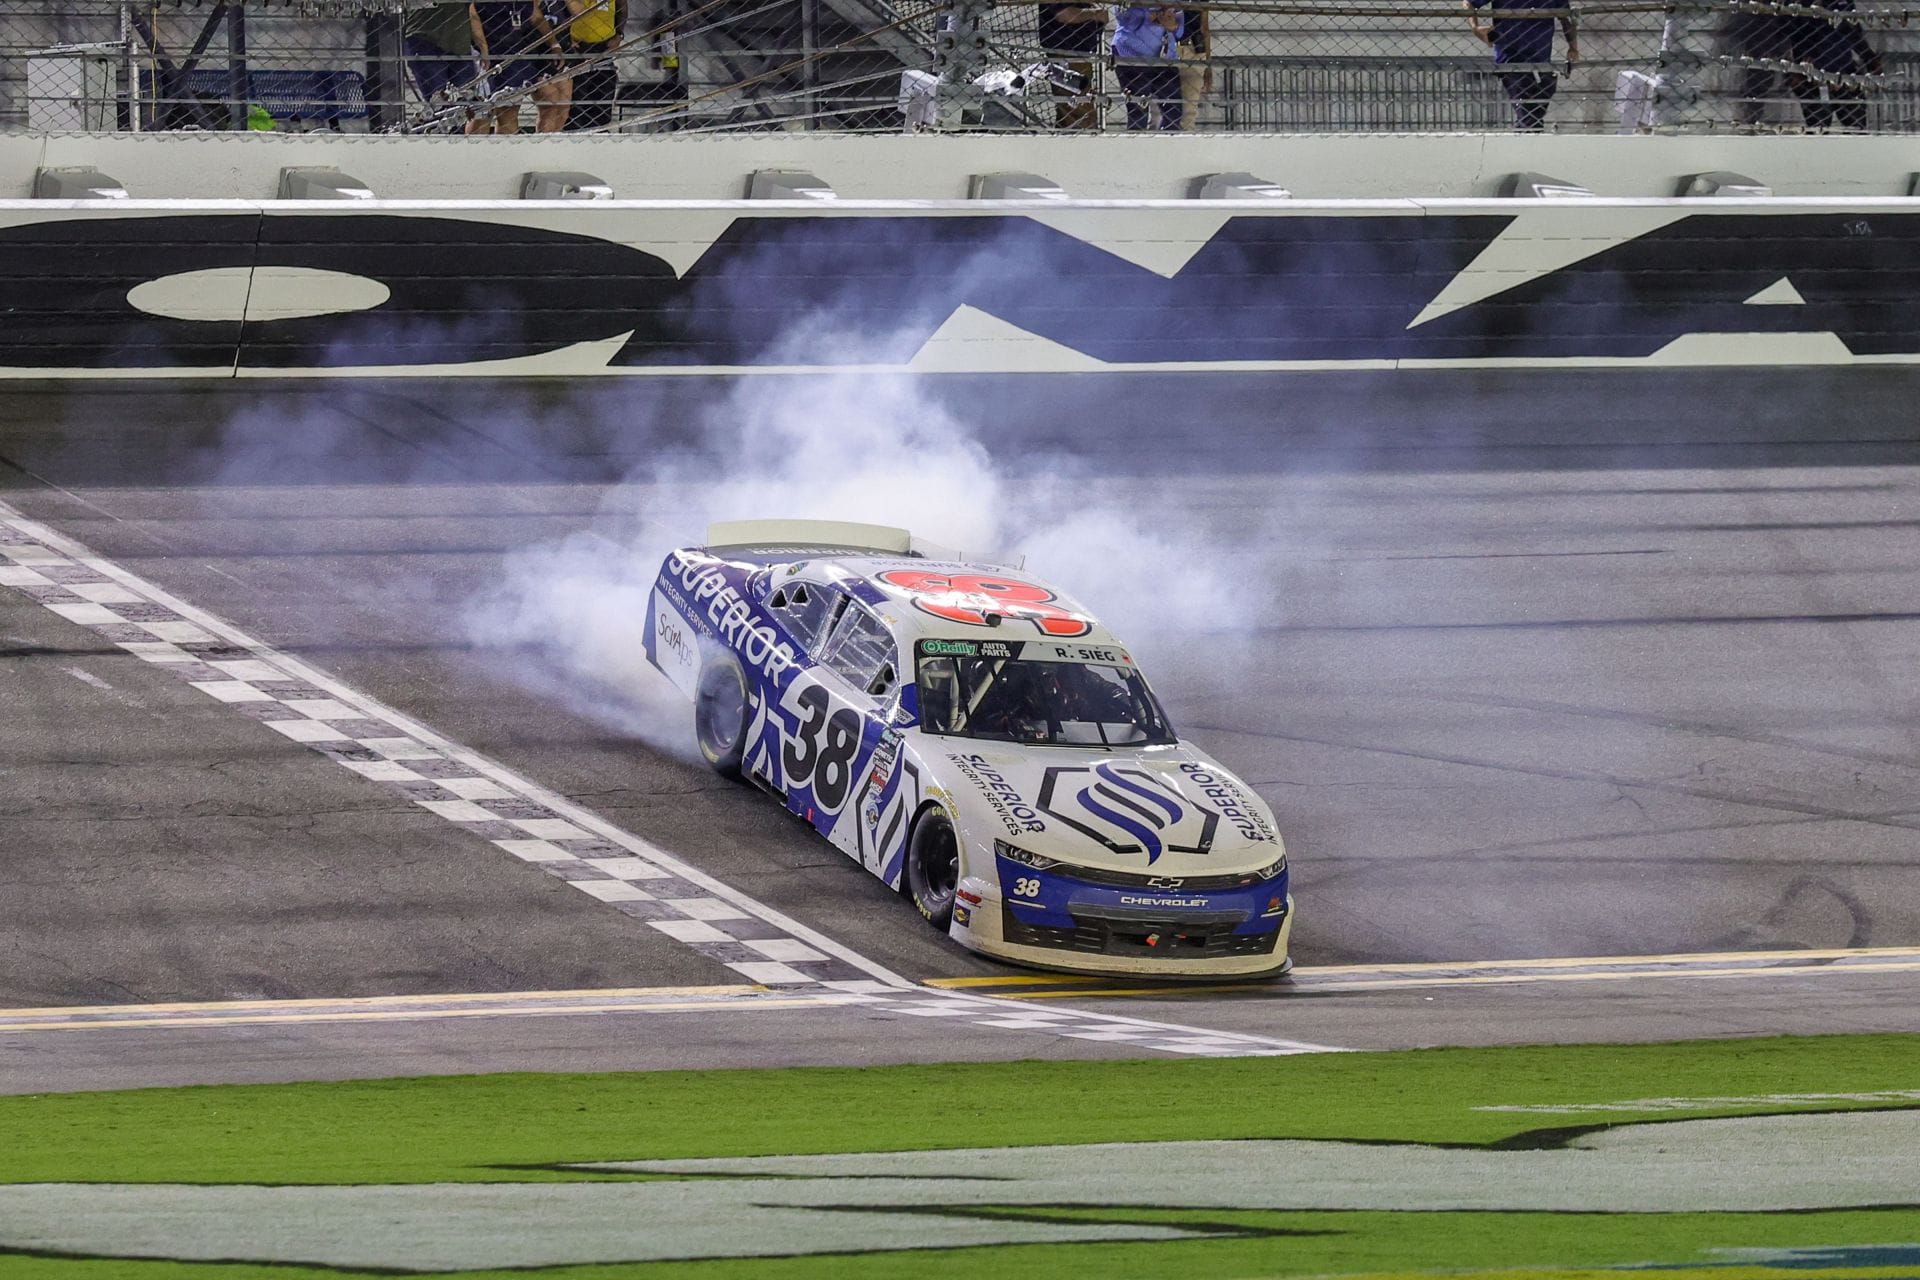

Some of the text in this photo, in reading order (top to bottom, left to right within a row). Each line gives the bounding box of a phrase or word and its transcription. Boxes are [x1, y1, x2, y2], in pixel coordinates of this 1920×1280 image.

[660, 574, 713, 640] INTEGRITY SERVICES
[668, 555, 795, 689] SUPERIOR
[922, 639, 977, 656] O'Reilly
[981, 649, 1011, 658] PARTS
[982, 642, 1006, 651] AUTO
[1055, 647, 1074, 659] R.
[1081, 649, 1116, 662] SIEG
[782, 684, 862, 810] 38
[945, 753, 1022, 836] INTEGRITY SERVICES
[961, 754, 1046, 833] SUPERIOR
[1180, 763, 1265, 841] SUPERIOR
[1241, 801, 1279, 845] INTEGRITY
[1013, 877, 1041, 898] 38
[1120, 896, 1209, 908] CHEVROLET
